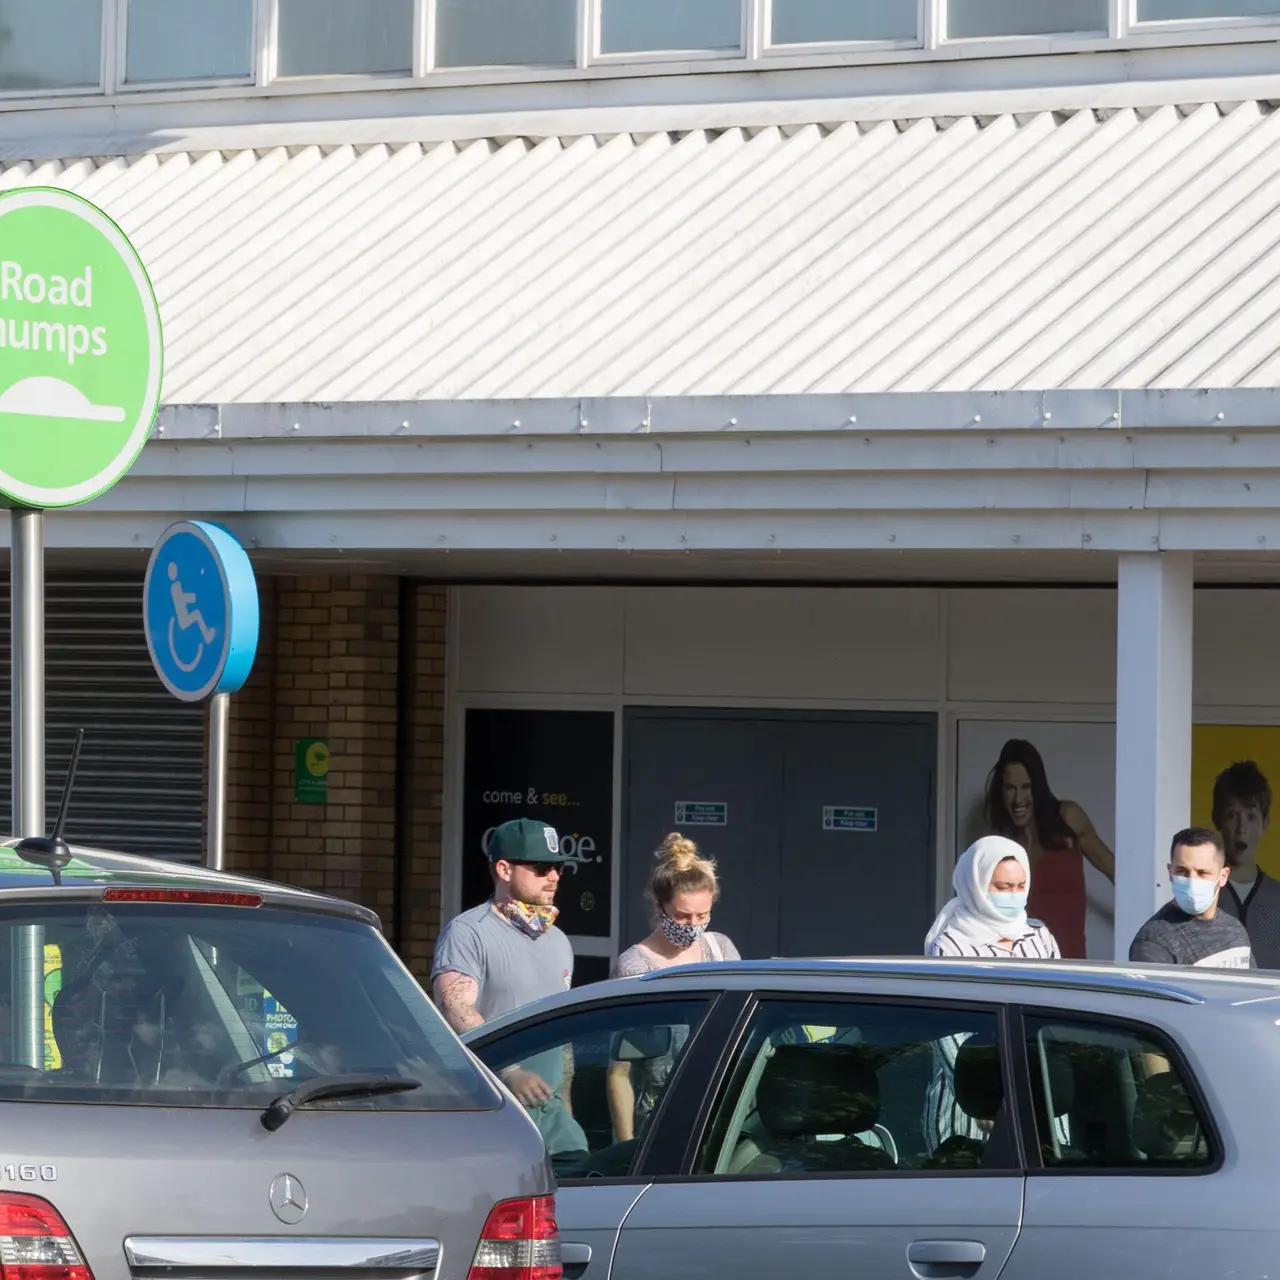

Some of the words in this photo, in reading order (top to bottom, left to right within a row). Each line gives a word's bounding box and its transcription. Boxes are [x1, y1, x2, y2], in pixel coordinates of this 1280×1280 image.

[1, 260, 92, 307] Road
[482, 790, 523, 805] come
[526, 787, 539, 805] &
[266, 1013, 297, 1022] PHOTO
